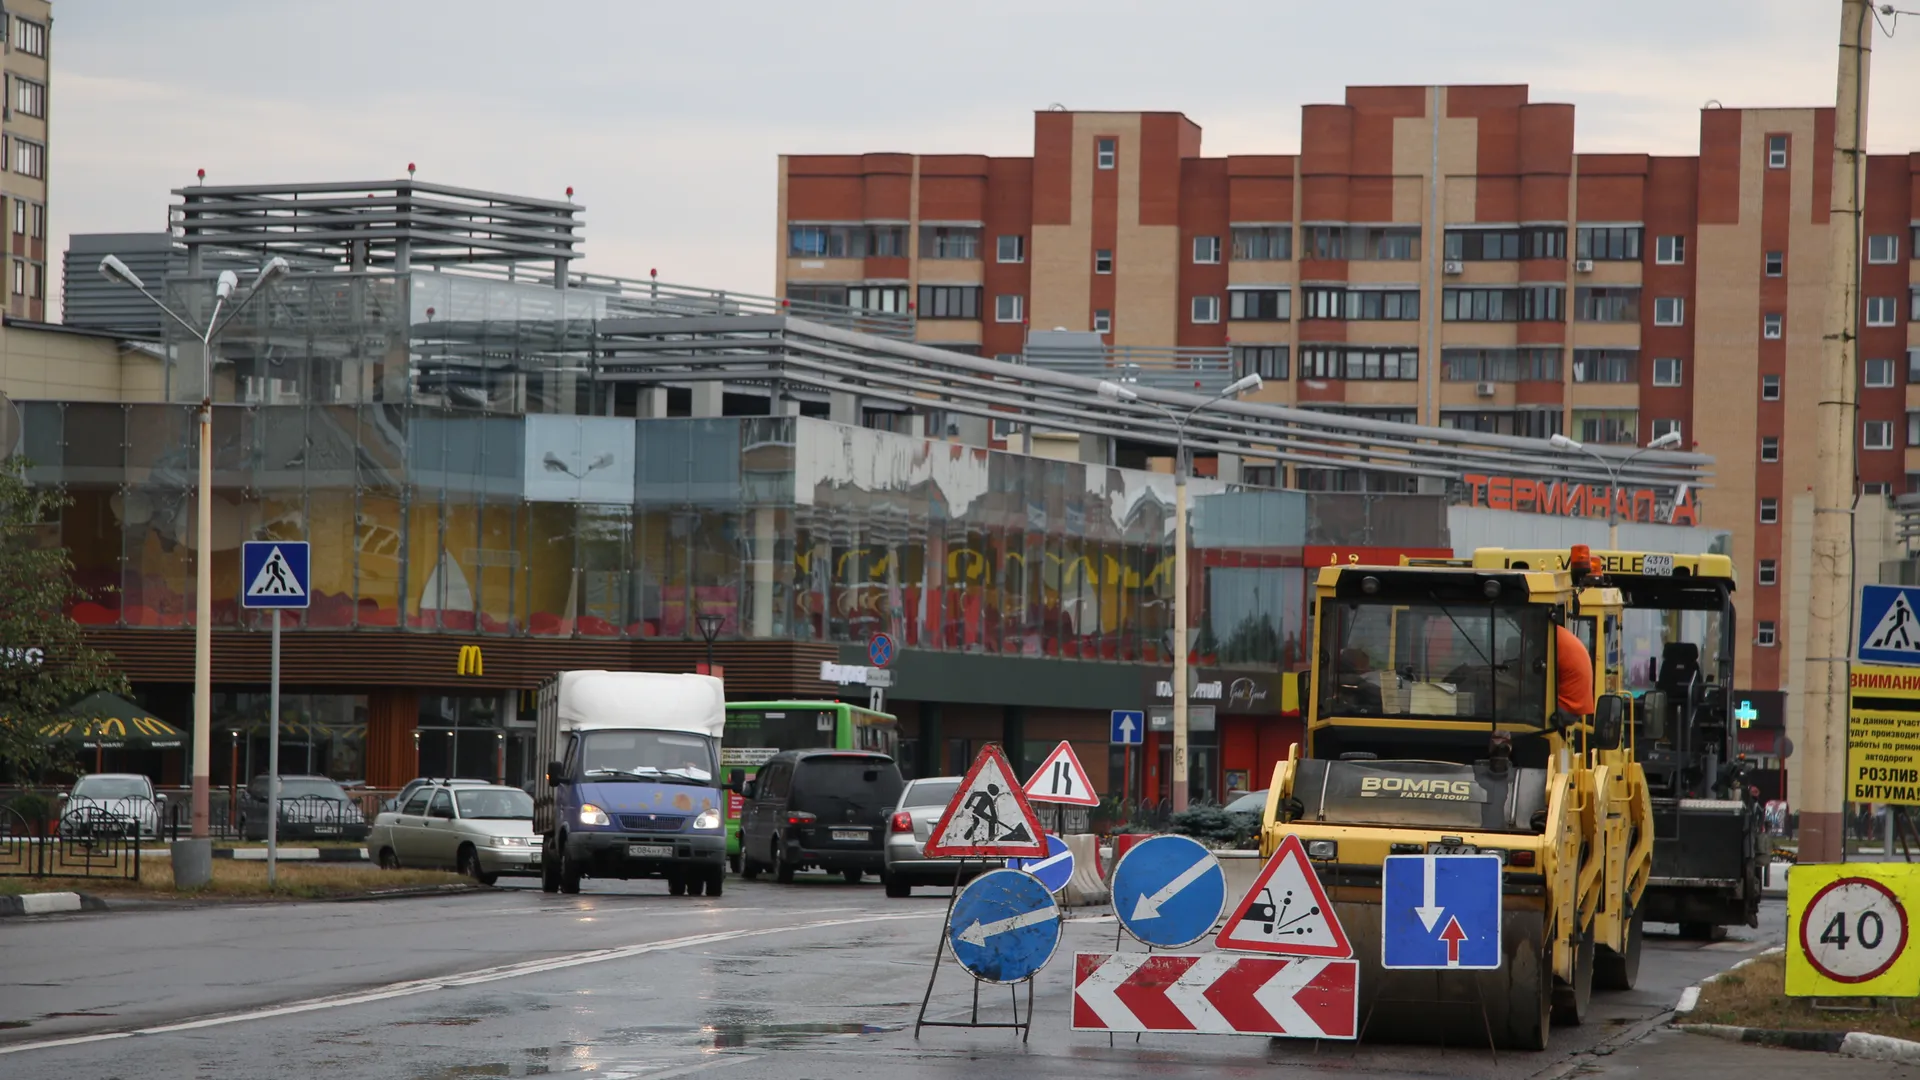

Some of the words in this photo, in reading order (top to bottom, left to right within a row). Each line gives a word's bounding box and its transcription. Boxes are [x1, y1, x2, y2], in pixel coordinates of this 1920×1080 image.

[1463, 473, 1656, 523] ТЕРМИНАЛ
[1668, 483, 1697, 526] А
[1557, 555, 1643, 572] VGELE
[1647, 556, 1670, 565] 4378
[1863, 717, 1894, 727] данном
[1850, 728, 1868, 738] удут
[1849, 739, 1880, 749] работы
[1882, 742, 1892, 750] по
[1865, 753, 1913, 764] автодороги
[1859, 767, 1919, 783] РОЗЛИВ
[1361, 777, 1472, 795] BOMAG
[1400, 791, 1432, 799] FAYAT
[1820, 911, 1884, 950] 40
